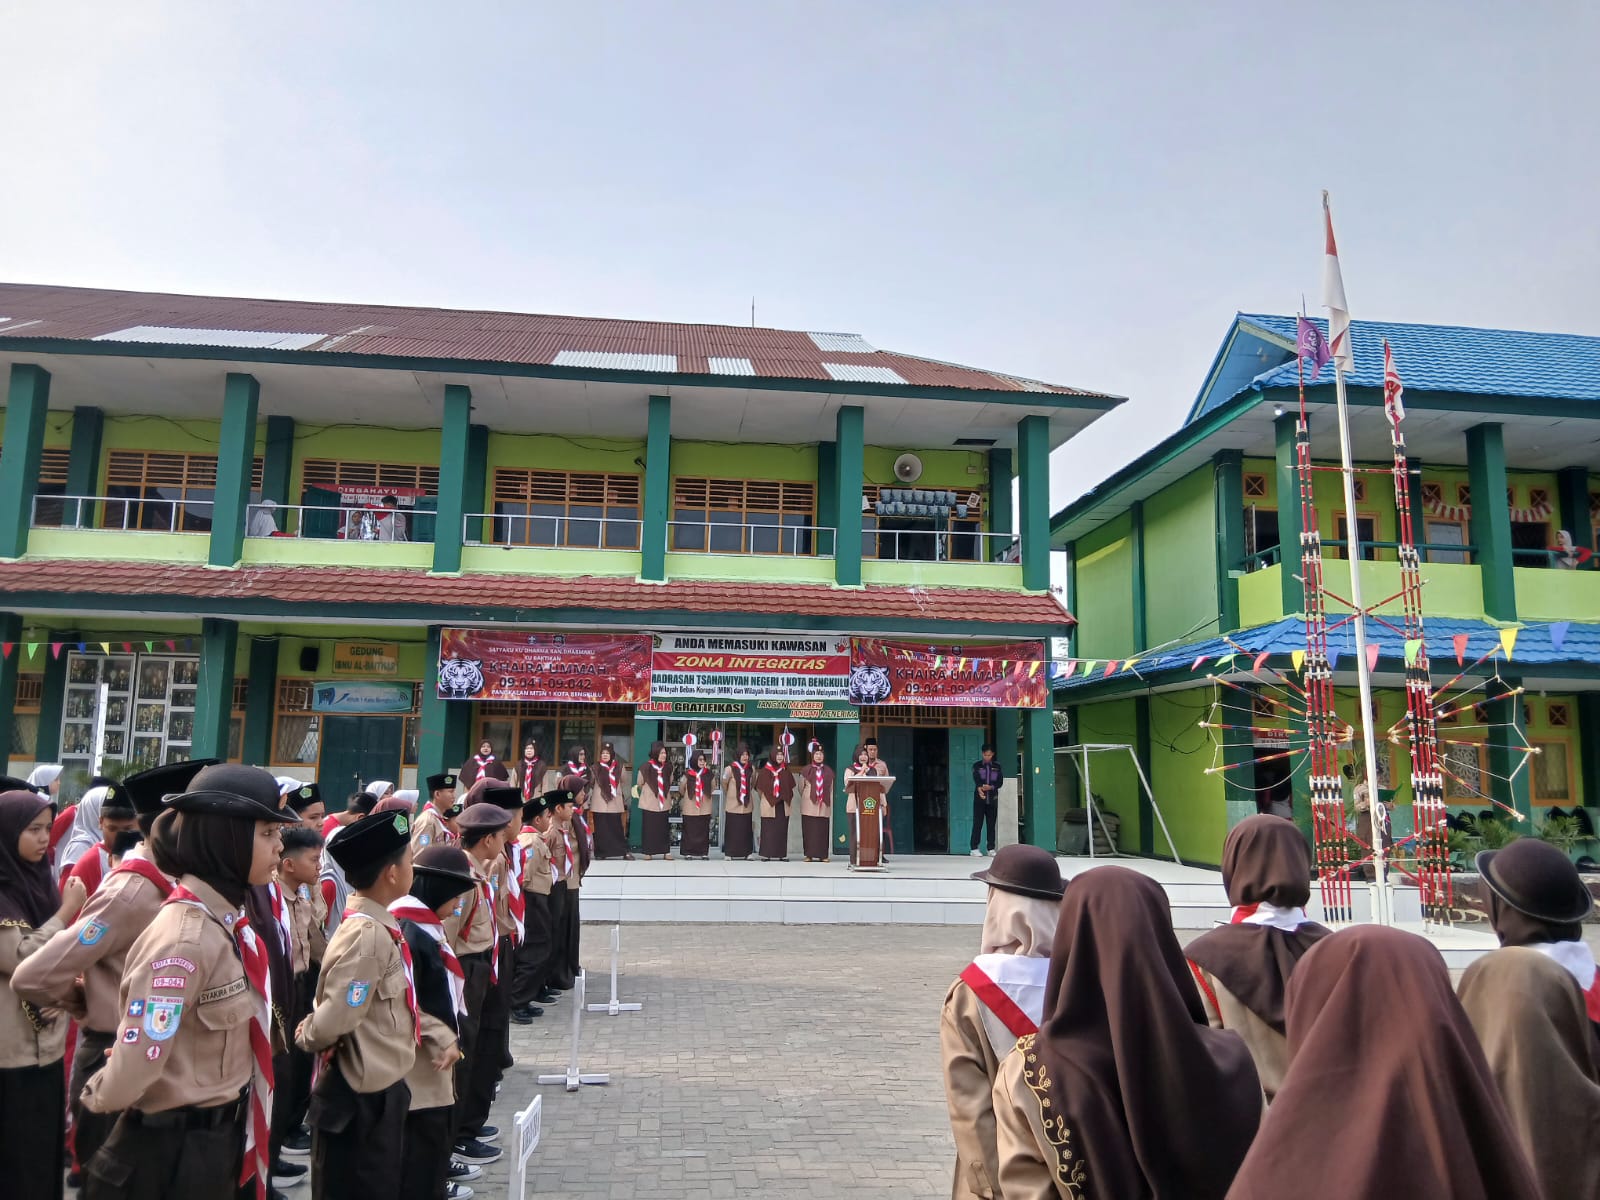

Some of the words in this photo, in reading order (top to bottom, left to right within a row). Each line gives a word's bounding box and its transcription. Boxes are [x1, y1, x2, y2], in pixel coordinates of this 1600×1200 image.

[337, 487, 398, 495] DIRGAHAYU
[350, 646, 384, 656] GEDUNG
[674, 638, 706, 649] ANDA
[708, 639, 768, 651] MEMASUKI
[771, 640, 827, 652] KAWASAN
[489, 661, 544, 673] KHAIRA
[549, 663, 607, 675] UMMAH
[674, 656, 724, 668] ZONA
[727, 657, 827, 670] INTEGRITAS
[652, 673, 695, 685] MADRASAH
[696, 675, 749, 686] TSANAWIYAH
[751, 676, 779, 687] NEGERI
[780, 676, 784, 687] 1
[786, 677, 807, 687] KOTA
[808, 677, 849, 688] BENGKULU
[896, 668, 946, 680] KHAIRA
[951, 670, 1006, 681] UMMAH
[659, 685, 679, 694] Wilayah
[696, 686, 715, 695] Korupsi
[745, 687, 764, 697] Wilayah
[789, 688, 805, 696] Bersih
[806, 688, 815, 696] dan
[816, 688, 838, 697] Melayani
[637, 702, 672, 712] TOLAK
[674, 703, 745, 713] GRATIFIKASI
[757, 701, 788, 709] JANGAN
[788, 701, 824, 709] MEMBERI
[790, 709, 820, 718] JANGAN
[820, 710, 858, 719] MENERIMA
[156, 978, 182, 986] 09-042
[201, 988, 227, 1001] SYAKIRA
